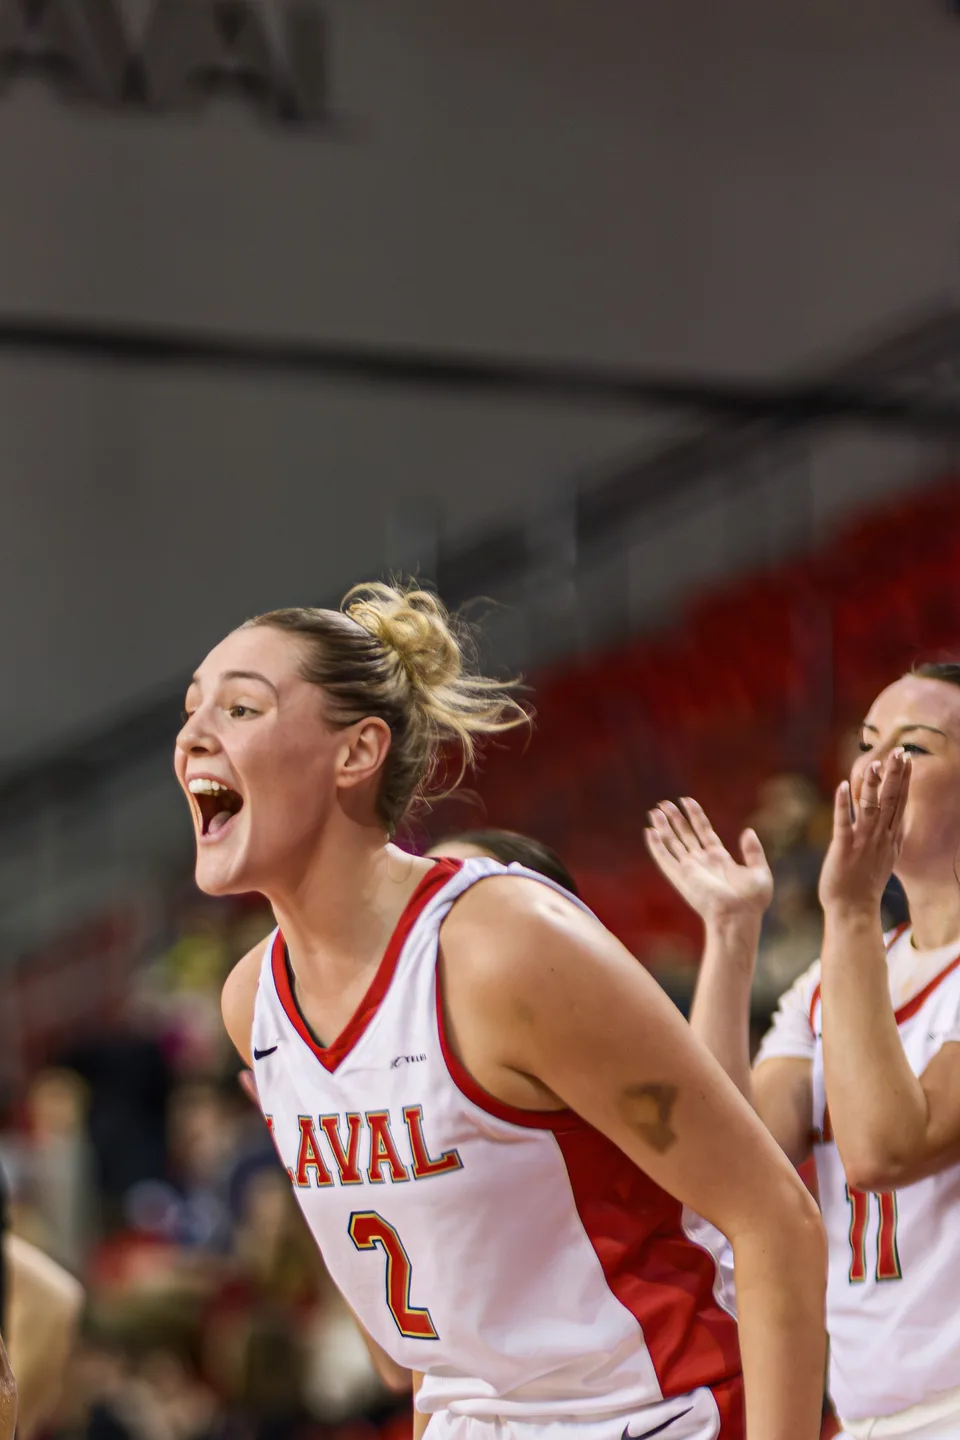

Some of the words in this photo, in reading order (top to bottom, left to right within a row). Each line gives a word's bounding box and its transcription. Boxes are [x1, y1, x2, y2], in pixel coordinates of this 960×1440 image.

[265, 1104, 464, 1189] AVAL
[348, 1210, 440, 1340] 2
[845, 1184, 903, 1284] 11
